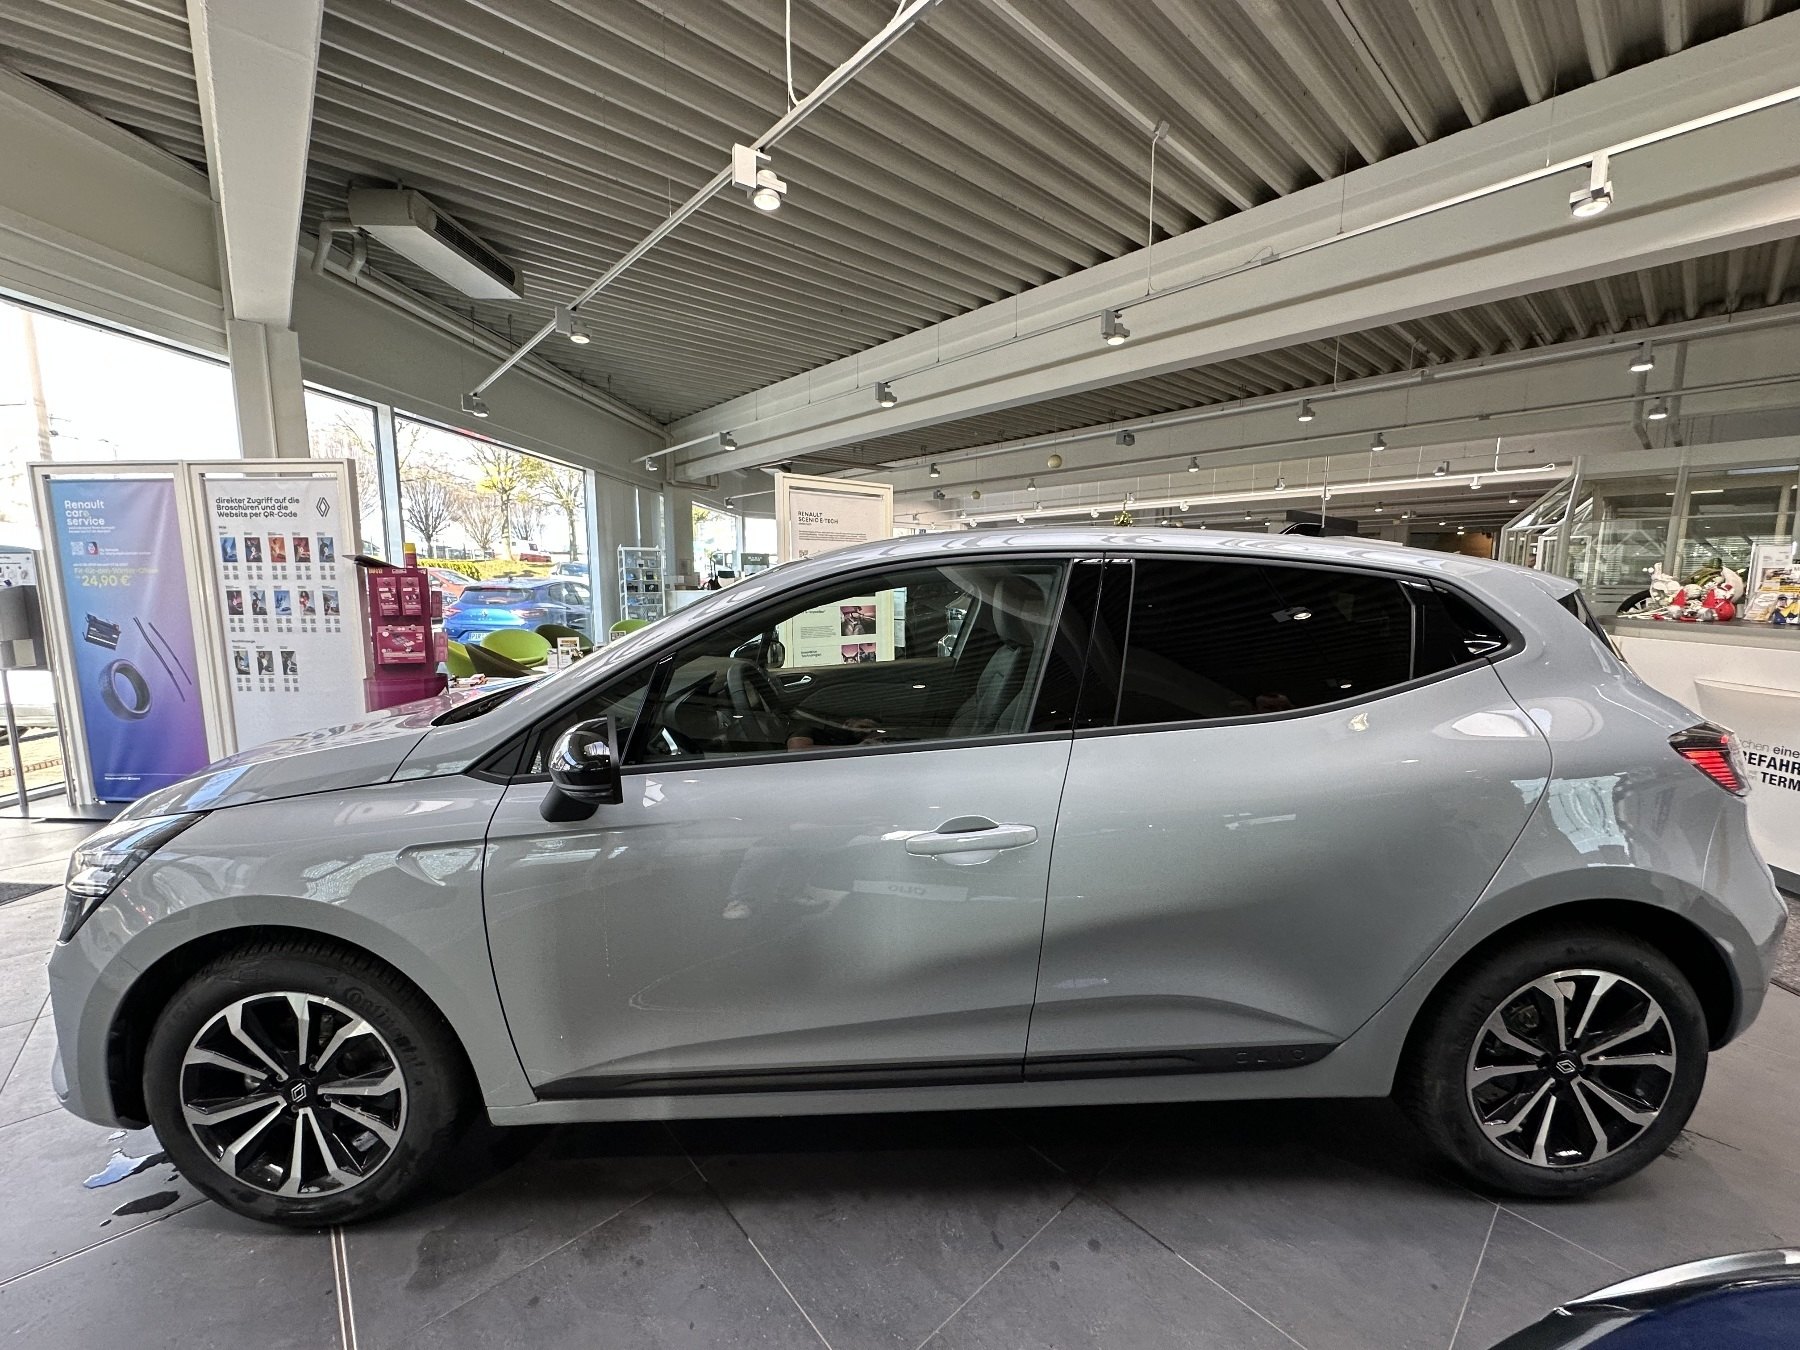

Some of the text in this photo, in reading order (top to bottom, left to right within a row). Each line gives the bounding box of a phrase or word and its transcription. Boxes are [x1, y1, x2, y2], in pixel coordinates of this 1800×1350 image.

[64, 500, 105, 509] Renault
[247, 497, 273, 505] Zugriff
[216, 503, 260, 511] Broschüren
[66, 517, 105, 526] service
[82, 575, 130, 588] 24,90 €
[1742, 750, 1800, 776] EFAHR
[1761, 771, 1800, 792] TERM
